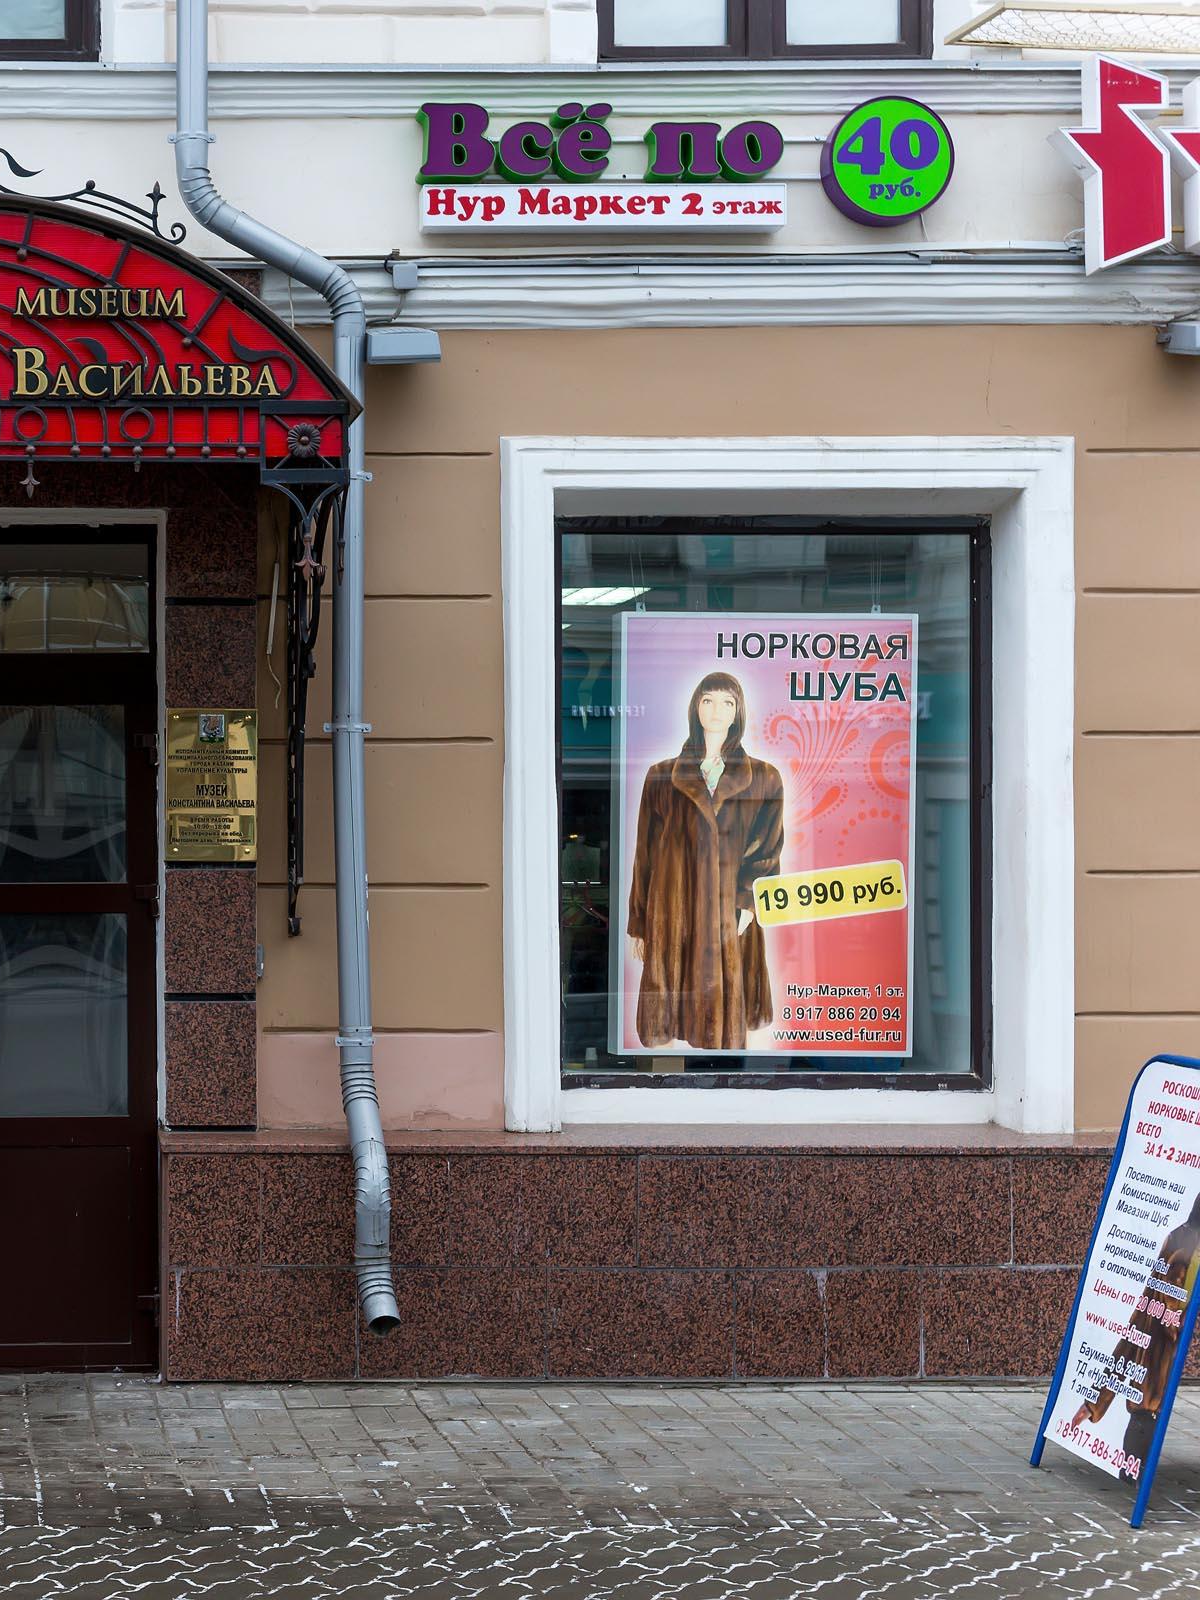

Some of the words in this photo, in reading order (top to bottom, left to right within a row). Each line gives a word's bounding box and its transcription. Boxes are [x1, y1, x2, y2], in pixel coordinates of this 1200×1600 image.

[417, 102, 612, 183] Всё
[644, 121, 784, 183] по
[837, 117, 940, 175] 40
[869, 176, 921, 200] руб.
[426, 188, 505, 221] Нур
[518, 188, 670, 221] Маркет
[680, 193, 703, 216] 2
[712, 200, 784, 214] этаж
[14, 286, 187, 318] MUSEUM
[716, 632, 908, 660] НОРКОВАЯ
[790, 672, 906, 701] ШУБА
[169, 799, 215, 808] КОНСТАНТИНА
[216, 799, 255, 808] ВАСИЛЬЕВА
[196, 782, 227, 796] МУЗЕЙ
[759, 888, 789, 911] 19
[797, 880, 844, 906] 990
[853, 876, 902, 904] руб.
[787, 984, 871, 998] Нур-Маркет,
[874, 985, 882, 996] 1
[887, 988, 904, 997] эт.
[783, 1007, 791, 1020] 8
[796, 1007, 823, 1020] 917
[828, 1007, 855, 1020] 886
[860, 1007, 877, 1020] 20
[882, 1007, 901, 1020] 94
[773, 1028, 901, 1041] www.used-fur.ru
[1147, 1100, 1195, 1124] НОРКОВЫЕ
[1136, 1121, 1162, 1139] ВСЕГО
[1144, 1142, 1155, 1156] ЗА
[1156, 1144, 1175, 1161] 1-2
[1125, 1166, 1168, 1189] Посетите
[1168, 1180, 1186, 1195] наш
[1120, 1182, 1181, 1212] Комиссионный
[1115, 1199, 1150, 1220] Магазин
[1150, 1209, 1170, 1228] Шуб.
[1107, 1224, 1157, 1251] Достойные
[1100, 1259, 1106, 1269] в
[1106, 1263, 1147, 1284] отличном
[1104, 1242, 1145, 1265] норковые
[1145, 1257, 1170, 1275] шубы
[1093, 1278, 1120, 1301] Цены
[1121, 1292, 1136, 1306] от
[1136, 1296, 1148, 1313] 20
[1147, 1300, 1166, 1319] 000
[1085, 1311, 1151, 1350] www.used-fur.ru
[1079, 1341, 1115, 1373] Баумана,
[1114, 1356, 1124, 1376] д.
[1070, 1378, 1077, 1392] 1
[1076, 1386, 1100, 1403] этаж
[1075, 1359, 1088, 1378] ТД
[1087, 1367, 1144, 1404] «Нур-Маркет»
[1061, 1422, 1141, 1479] 8-917-886-20-94
